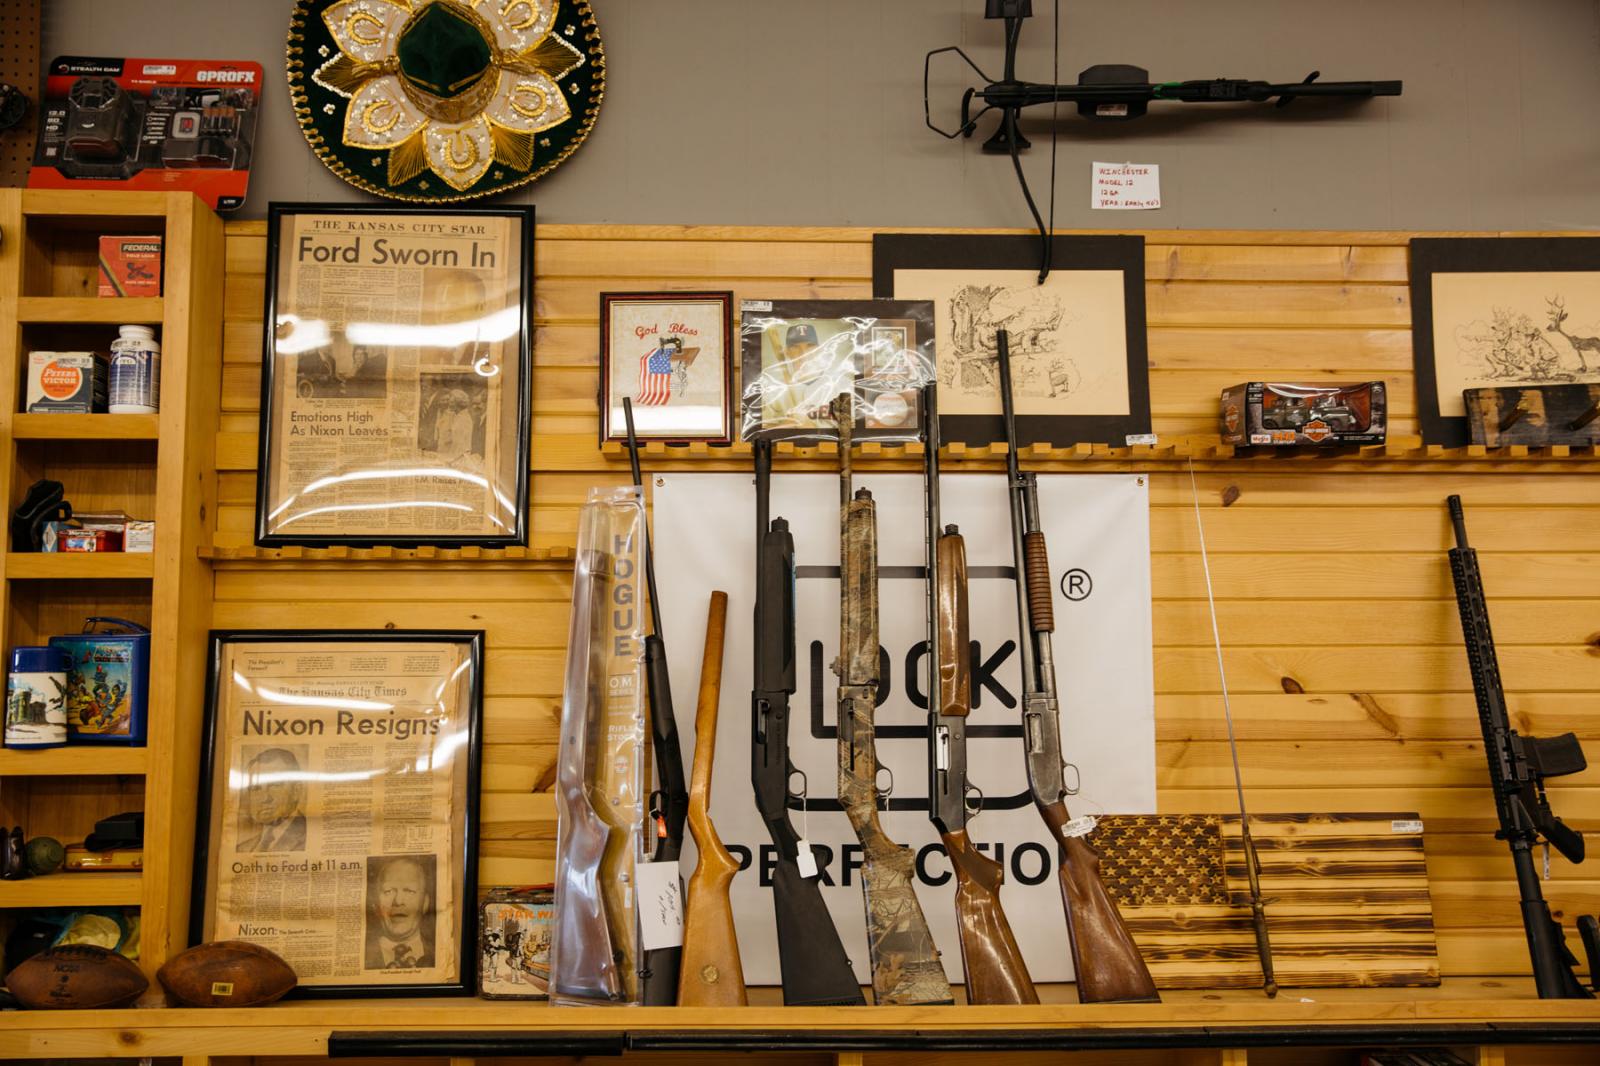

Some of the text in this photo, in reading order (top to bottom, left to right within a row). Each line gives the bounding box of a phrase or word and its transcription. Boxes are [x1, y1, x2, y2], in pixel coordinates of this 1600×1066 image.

[196, 70, 255, 83] GPROFX
[313, 220, 486, 235] THE KANSAS CITY STAR
[123, 244, 159, 252] FEDERAL
[298, 236, 496, 268] Ford Sworn In
[634, 322, 698, 340] God Bless
[290, 410, 374, 425] Emotions High
[290, 424, 389, 437] As Nixon Leaves
[613, 534, 634, 657] HOGUE
[348, 686, 372, 700] City
[374, 685, 408, 698] Times
[242, 710, 441, 741] Nixon Resigns
[231, 859, 363, 874] Oath to Ford at 11 a.m.
[238, 923, 278, 937] Nixon:
